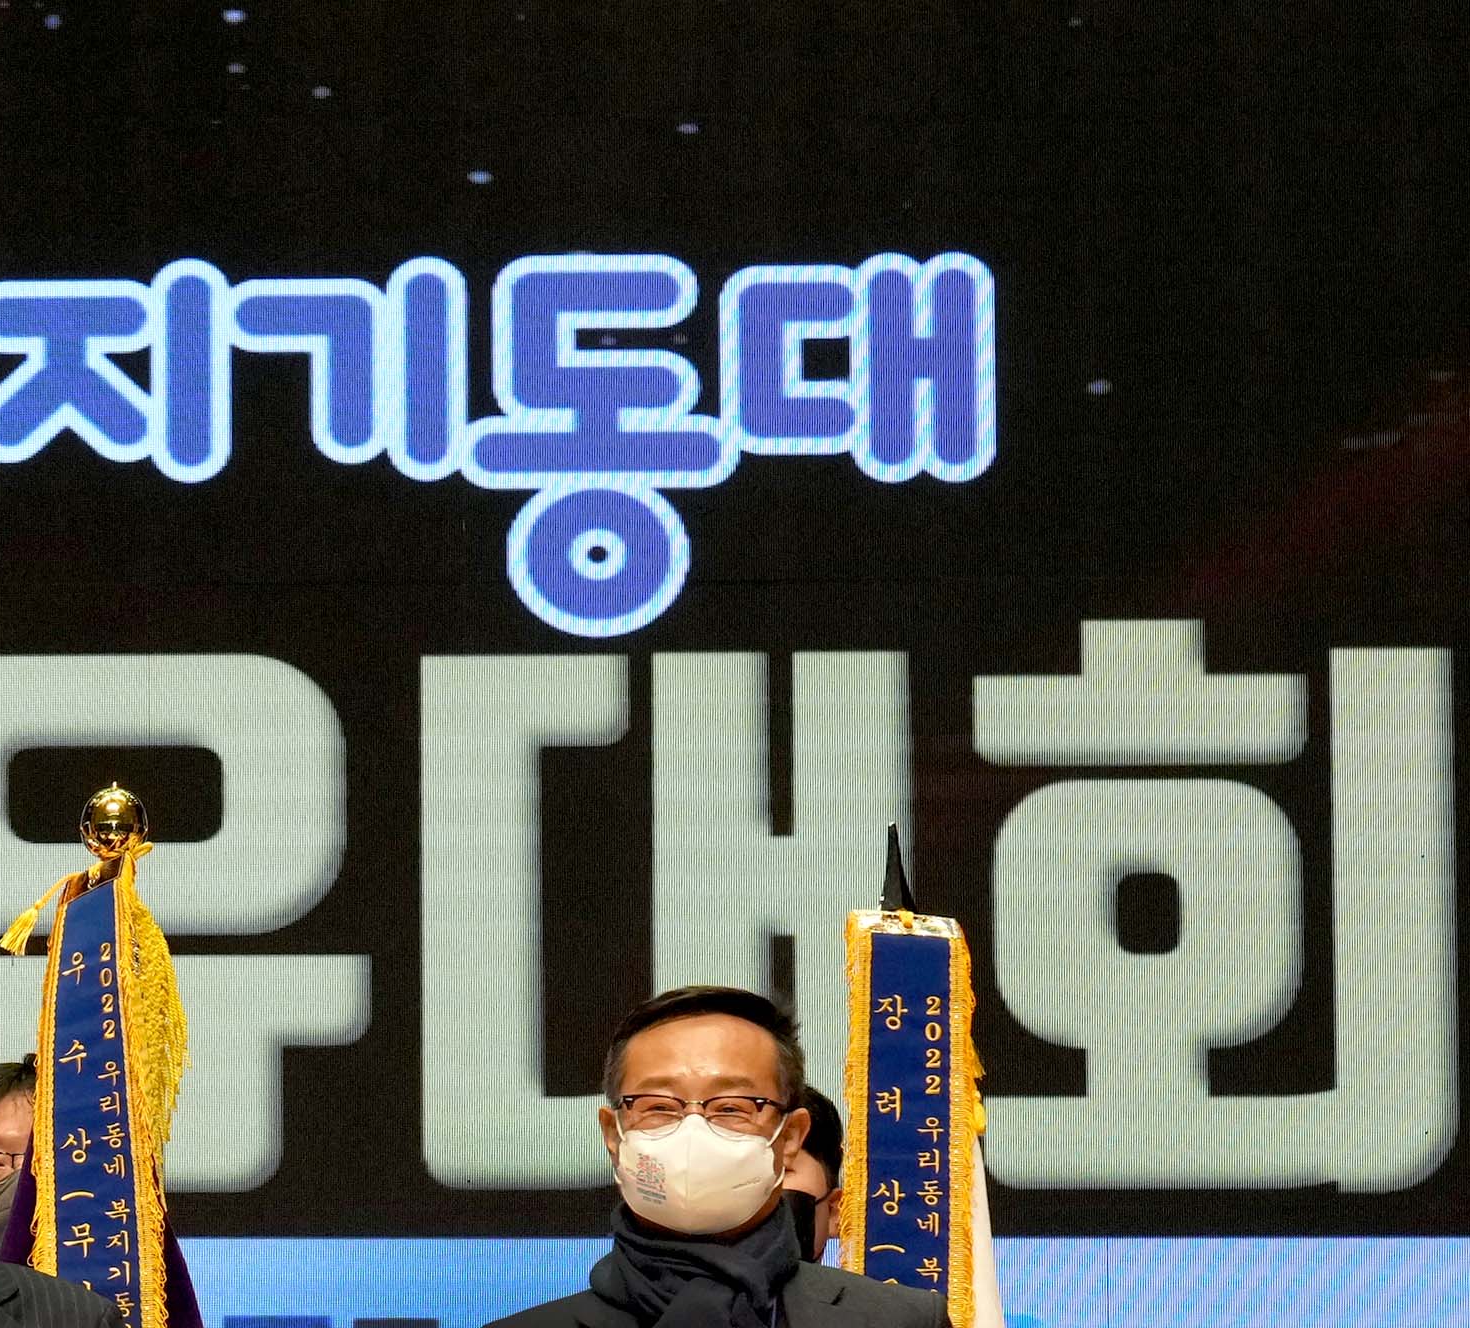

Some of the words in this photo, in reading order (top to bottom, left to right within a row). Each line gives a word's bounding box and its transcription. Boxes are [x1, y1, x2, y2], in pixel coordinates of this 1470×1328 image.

[99, 942, 116, 1040] 2022
[925, 996, 942, 1095] 2022
[97, 1060, 126, 1179] 우리동네
[916, 1117, 945, 1237] 우리동네
[915, 1257, 943, 1293] 복
